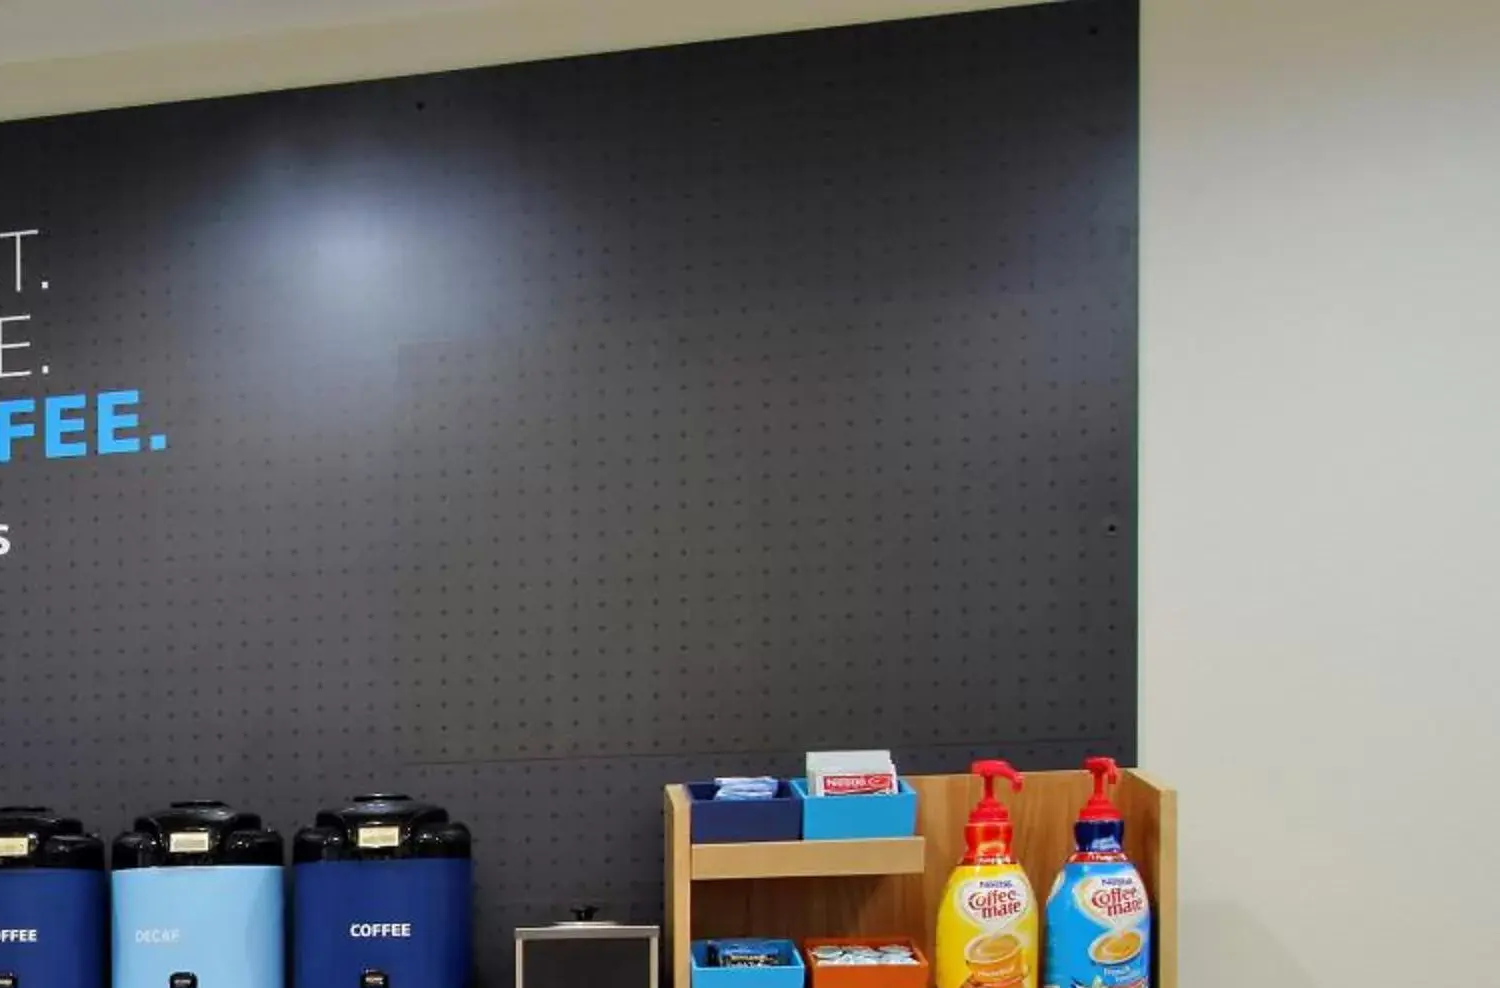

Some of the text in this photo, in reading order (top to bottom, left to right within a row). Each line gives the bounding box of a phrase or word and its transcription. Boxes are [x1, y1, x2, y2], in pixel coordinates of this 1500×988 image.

[967, 889, 1017, 911] Coffee
[981, 901, 1021, 918] mate
[135, 928, 181, 944] DECAF
[350, 923, 411, 938] COFFEE
